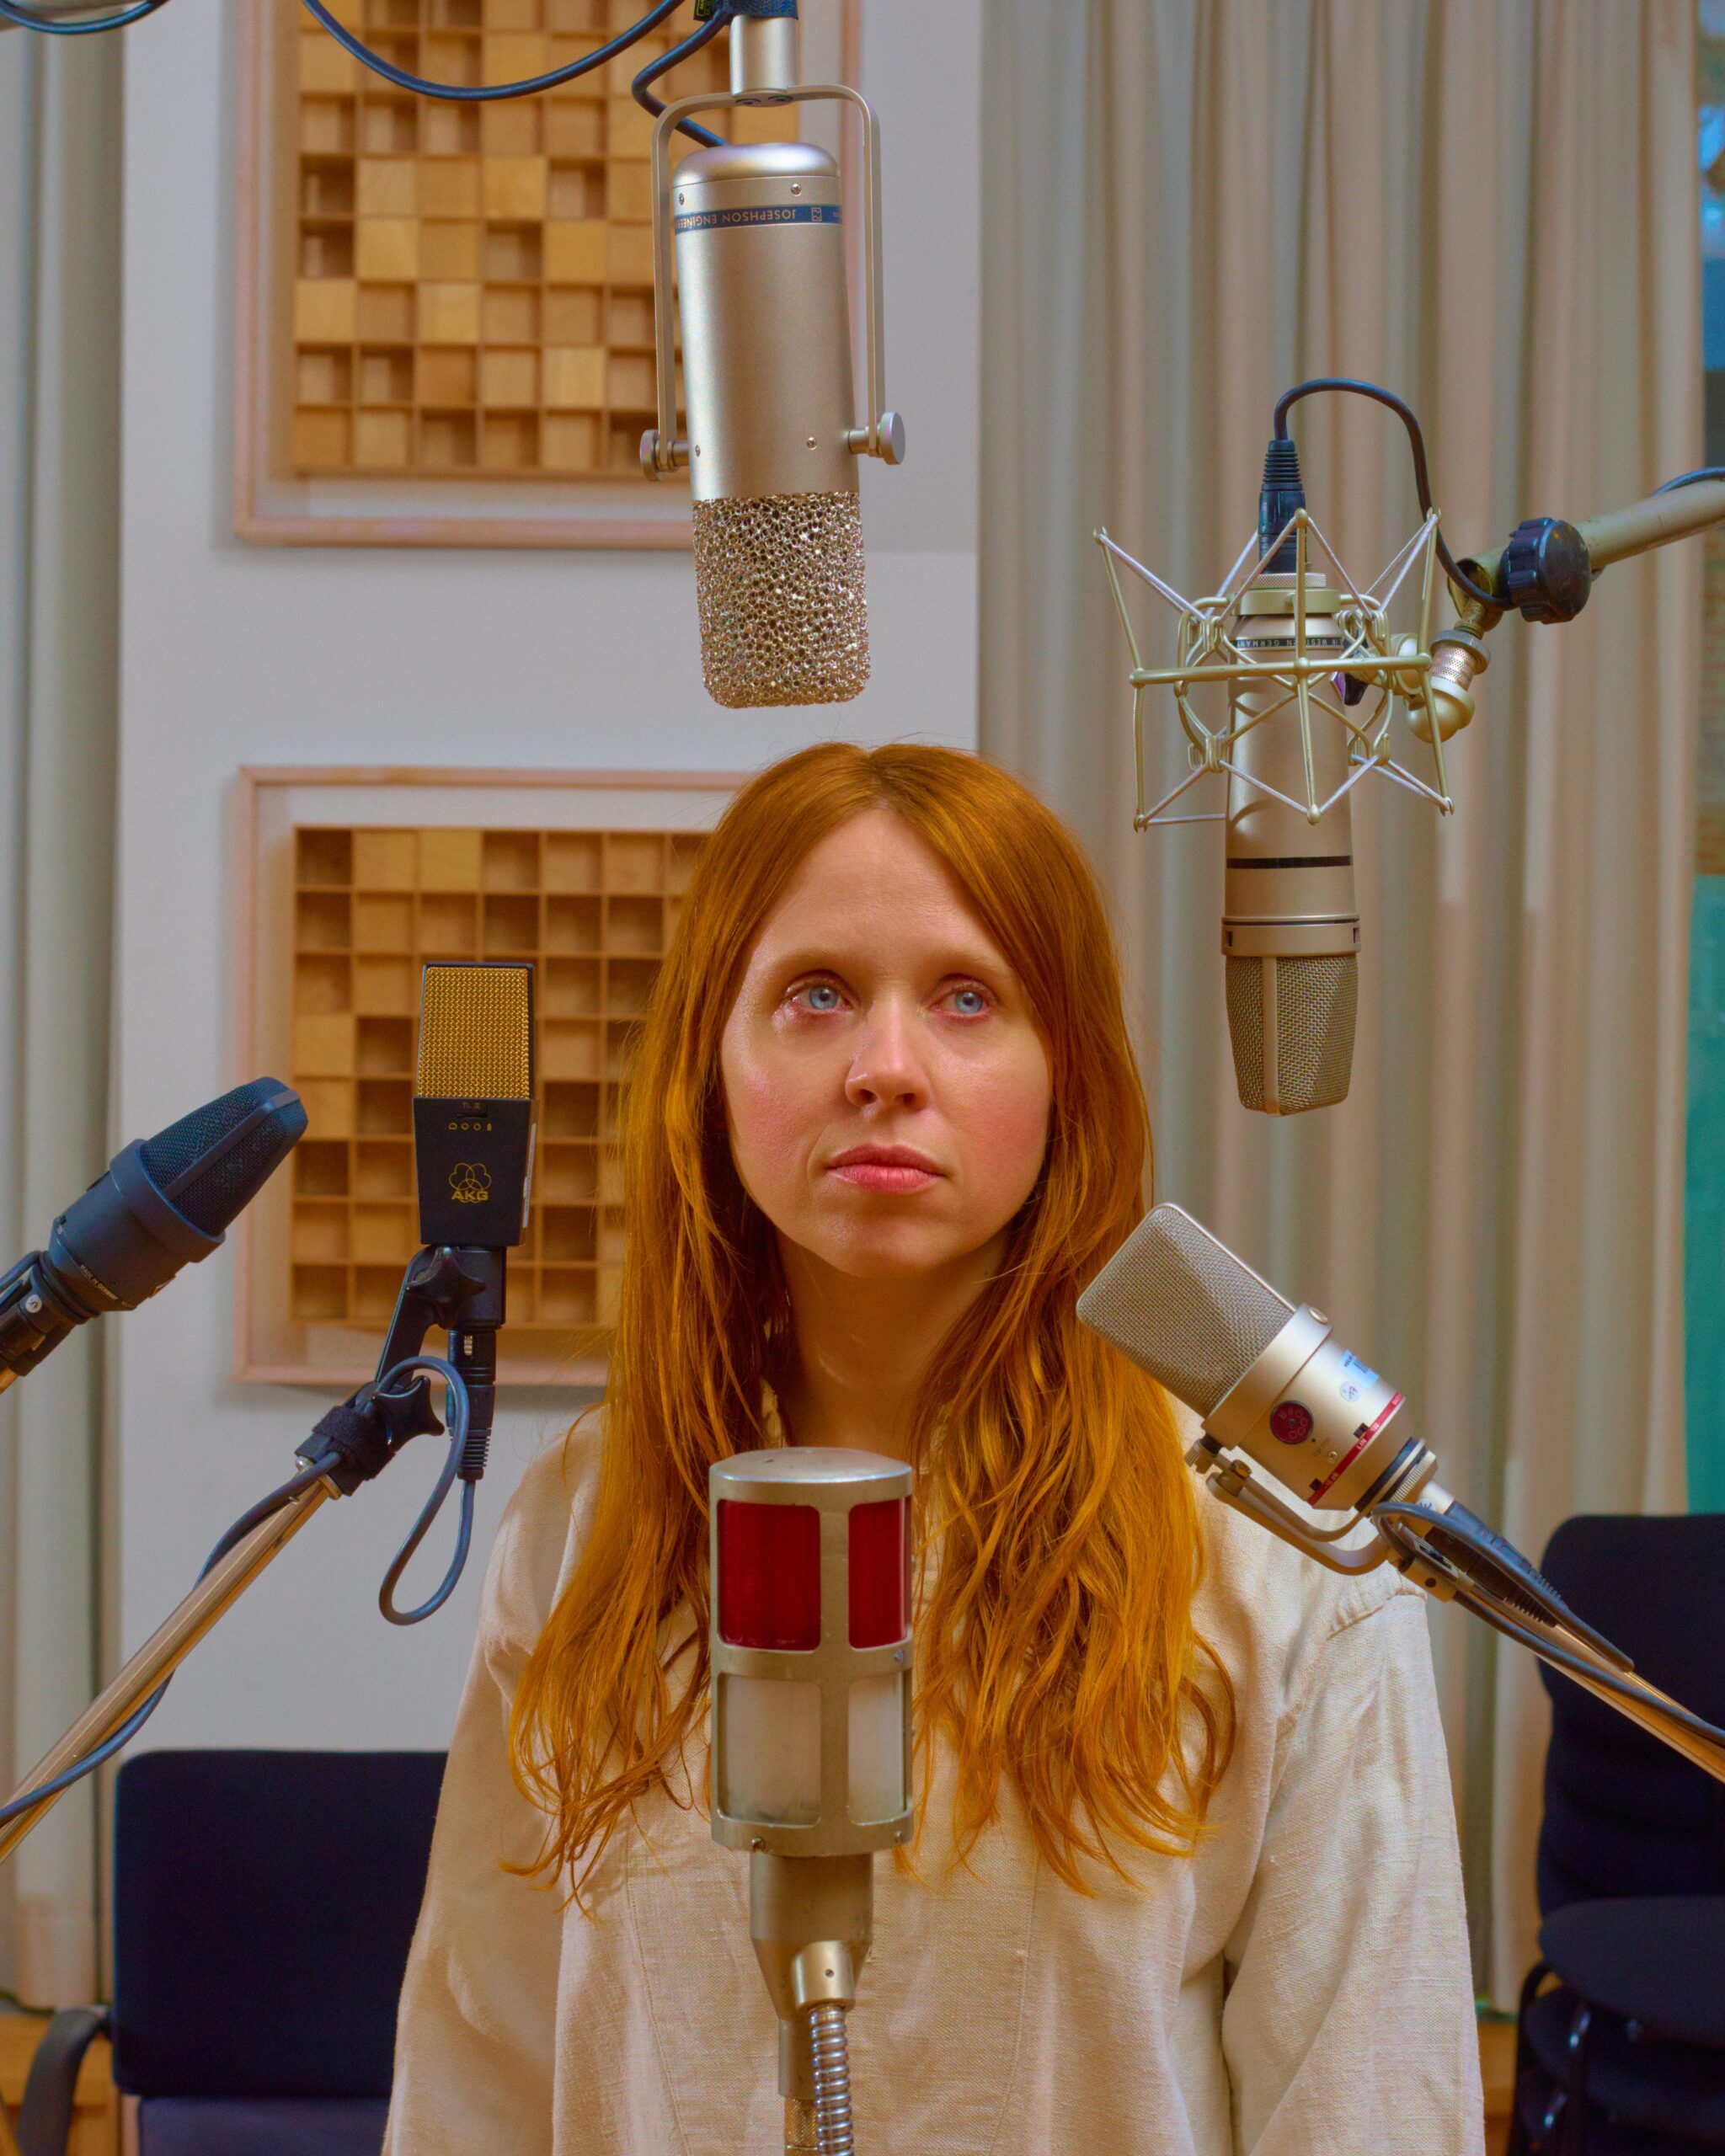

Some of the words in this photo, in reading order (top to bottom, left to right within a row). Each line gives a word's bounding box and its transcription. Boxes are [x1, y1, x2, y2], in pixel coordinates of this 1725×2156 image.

[722, 209, 795, 222] JOSEPHSON
[1236, 639, 1279, 648] GERMANY
[451, 1190, 489, 1201] AKG
[1356, 1438, 1367, 1449] LIN
